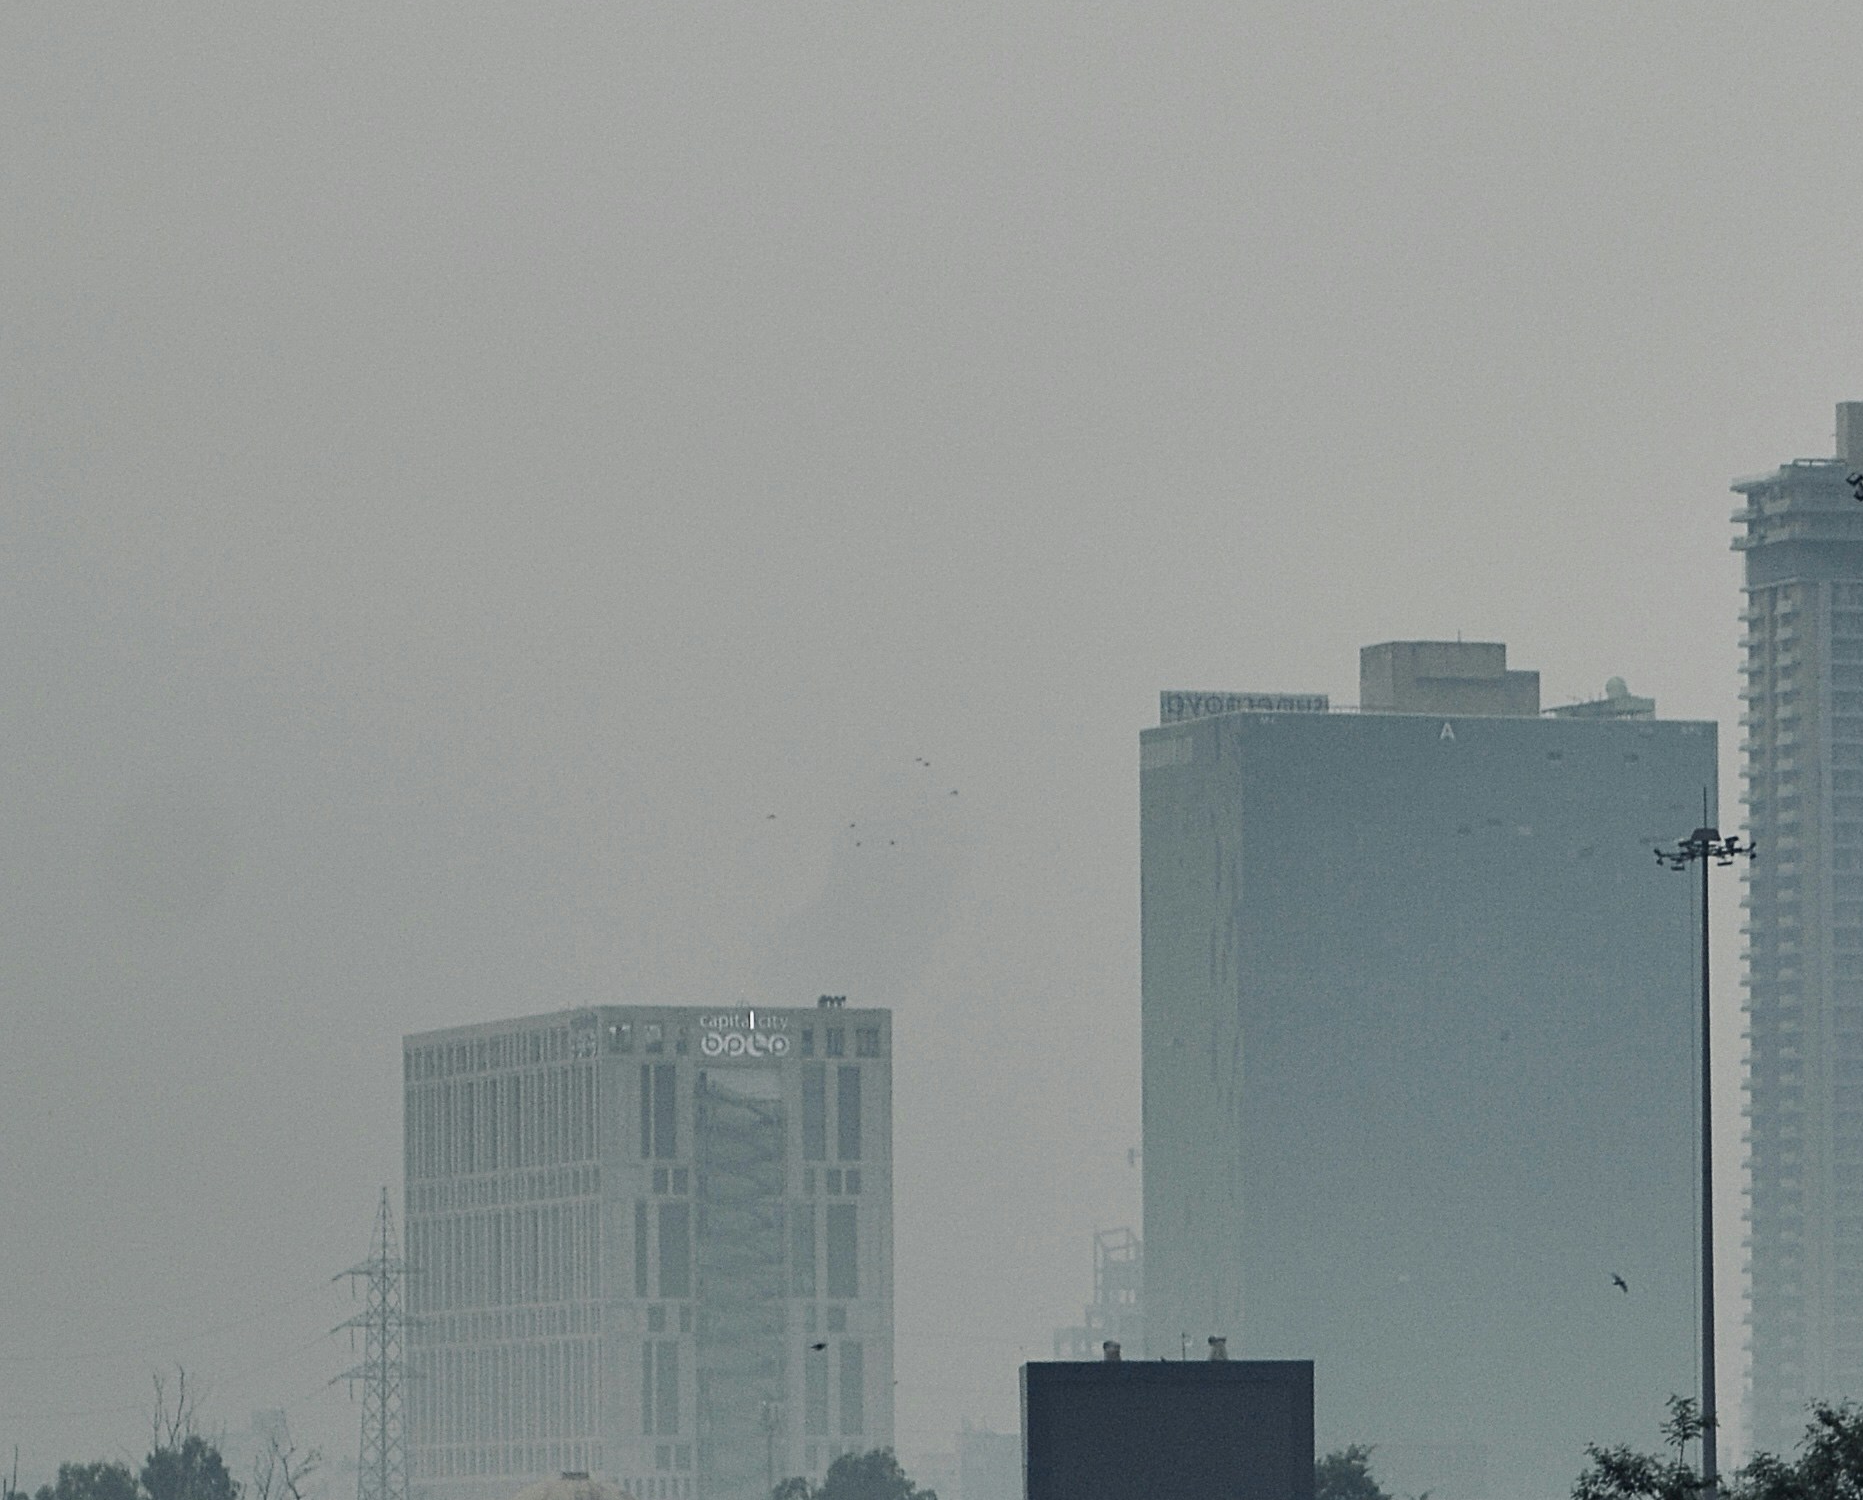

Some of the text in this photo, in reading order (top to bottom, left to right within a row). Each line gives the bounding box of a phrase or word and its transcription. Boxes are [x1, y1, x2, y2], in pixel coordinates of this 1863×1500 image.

[1439, 721, 1455, 740] A
[700, 1010, 788, 1031] capital city
